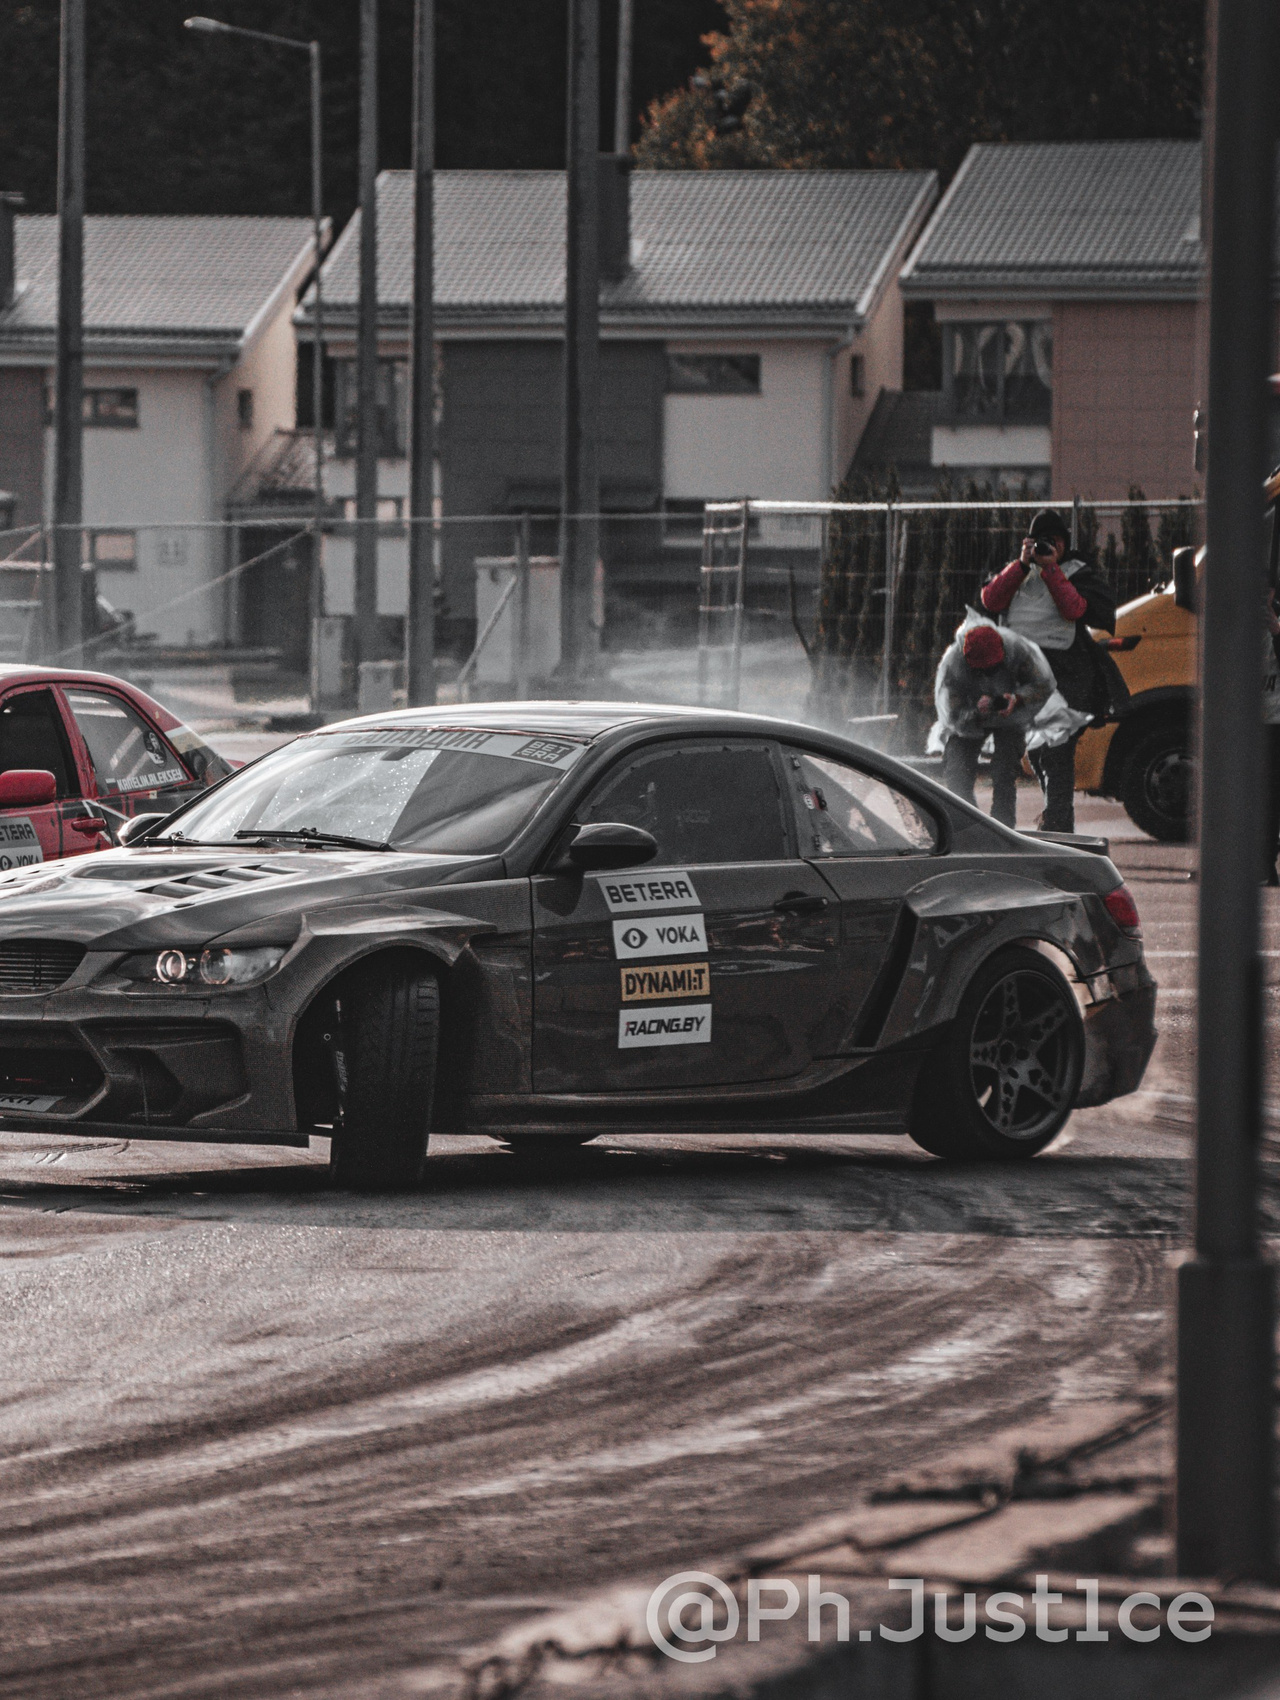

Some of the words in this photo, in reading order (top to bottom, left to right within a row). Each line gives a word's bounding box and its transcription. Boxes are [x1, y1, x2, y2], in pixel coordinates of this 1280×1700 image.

[529, 741, 570, 754] BET
[656, 925, 700, 944] VOKA
[624, 1016, 706, 1036] RACING.BY
